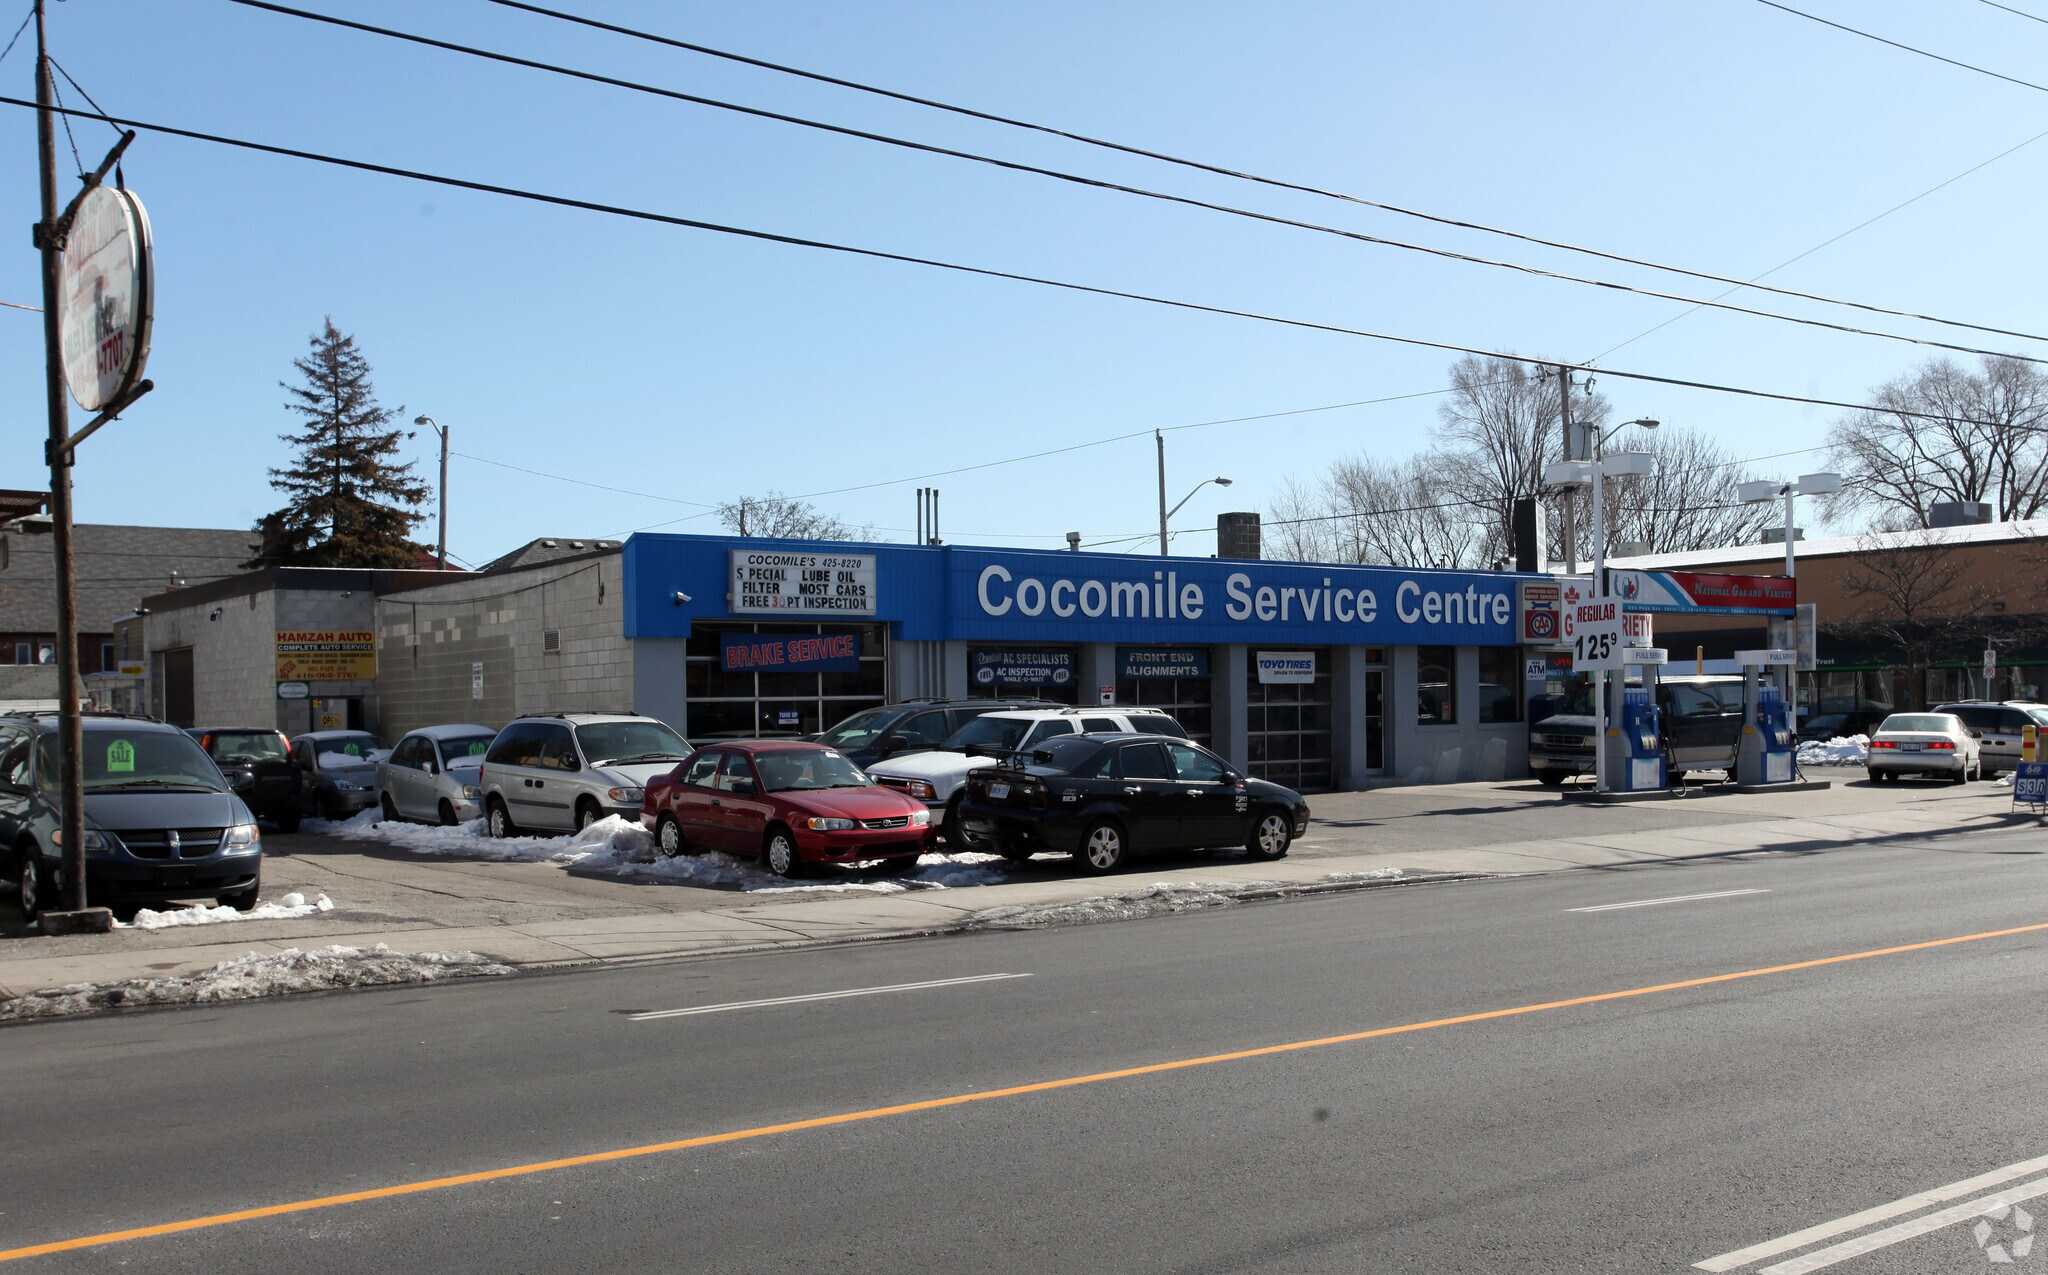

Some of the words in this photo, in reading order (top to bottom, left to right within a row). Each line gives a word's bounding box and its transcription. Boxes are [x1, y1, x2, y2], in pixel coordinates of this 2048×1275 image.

[748, 555, 816, 567] COCOMILE'S
[822, 558, 861, 568] 425-8220
[802, 570, 830, 582] LUBE
[837, 571, 856, 583] OIL
[742, 582, 780, 594] FILTER
[799, 583, 829, 595] MOST
[836, 585, 866, 596] CARS
[978, 564, 1204, 620] Cocomile
[1225, 573, 1377, 623] Service
[1396, 580, 1510, 625] Centre
[742, 596, 769, 607] FREE
[787, 597, 800, 608] PT
[804, 597, 867, 610] INSPECTION
[1577, 603, 1615, 623] REGULAR
[1622, 615, 1651, 637] RIETY
[277, 632, 334, 642] HAMZAH
[338, 632, 372, 642] AUTO
[278, 644, 319, 652] COMPLETE
[726, 642, 785, 668] BRAKE
[787, 635, 854, 663] SERVICE
[1003, 653, 1015, 664] AC
[1016, 653, 1069, 665] SPECIALISTS
[1129, 653, 1167, 662] FRONT
[1170, 653, 1194, 662] END
[1126, 666, 1199, 676] ALIGNMENTS
[1259, 660, 1285, 668] TOYO
[1285, 660, 1311, 669] TIRES
[1527, 665, 1545, 675] ATM
[996, 668, 1007, 676] AC
[1008, 668, 1051, 677] INSPECTION
[111, 750, 131, 763] SALE
